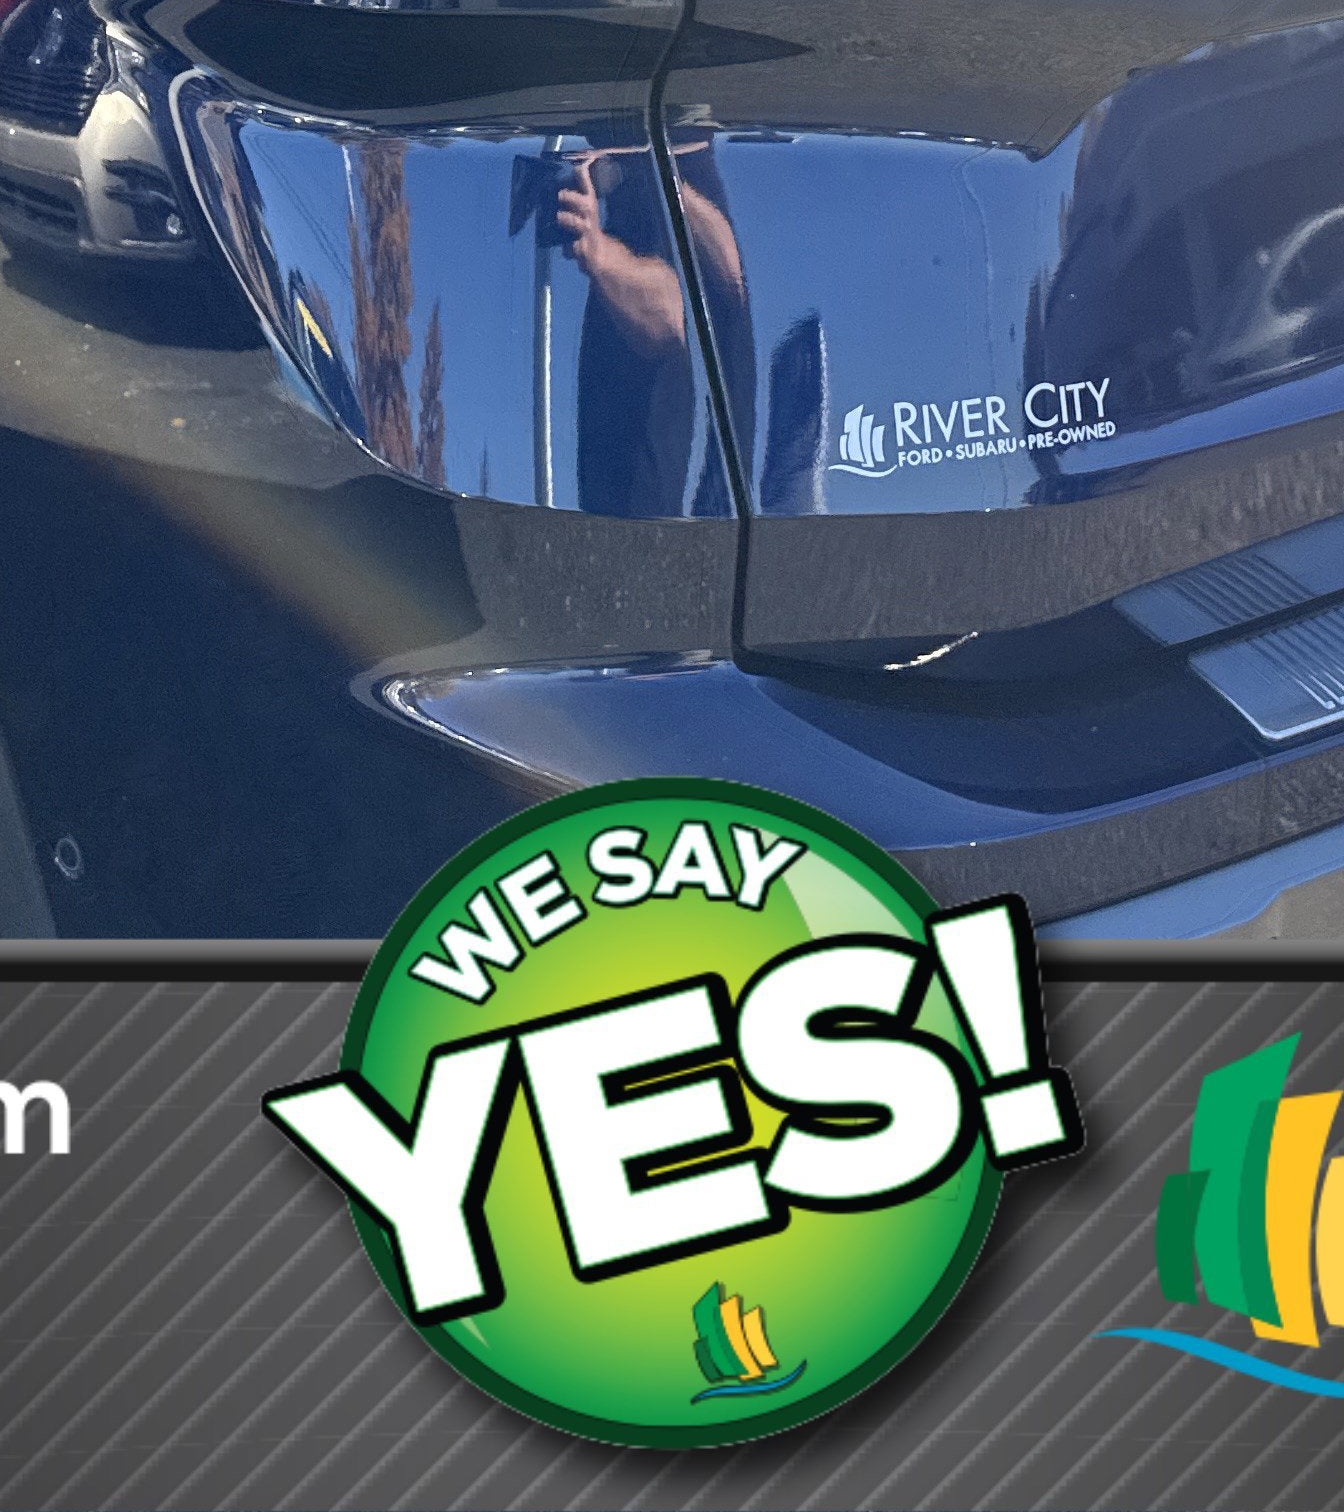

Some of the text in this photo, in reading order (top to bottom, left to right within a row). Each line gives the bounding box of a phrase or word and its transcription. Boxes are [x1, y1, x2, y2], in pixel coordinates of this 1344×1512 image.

[893, 377, 1110, 446] RIVER CITY
[897, 420, 1117, 468] FORD SUBARU PRE-OWNED
